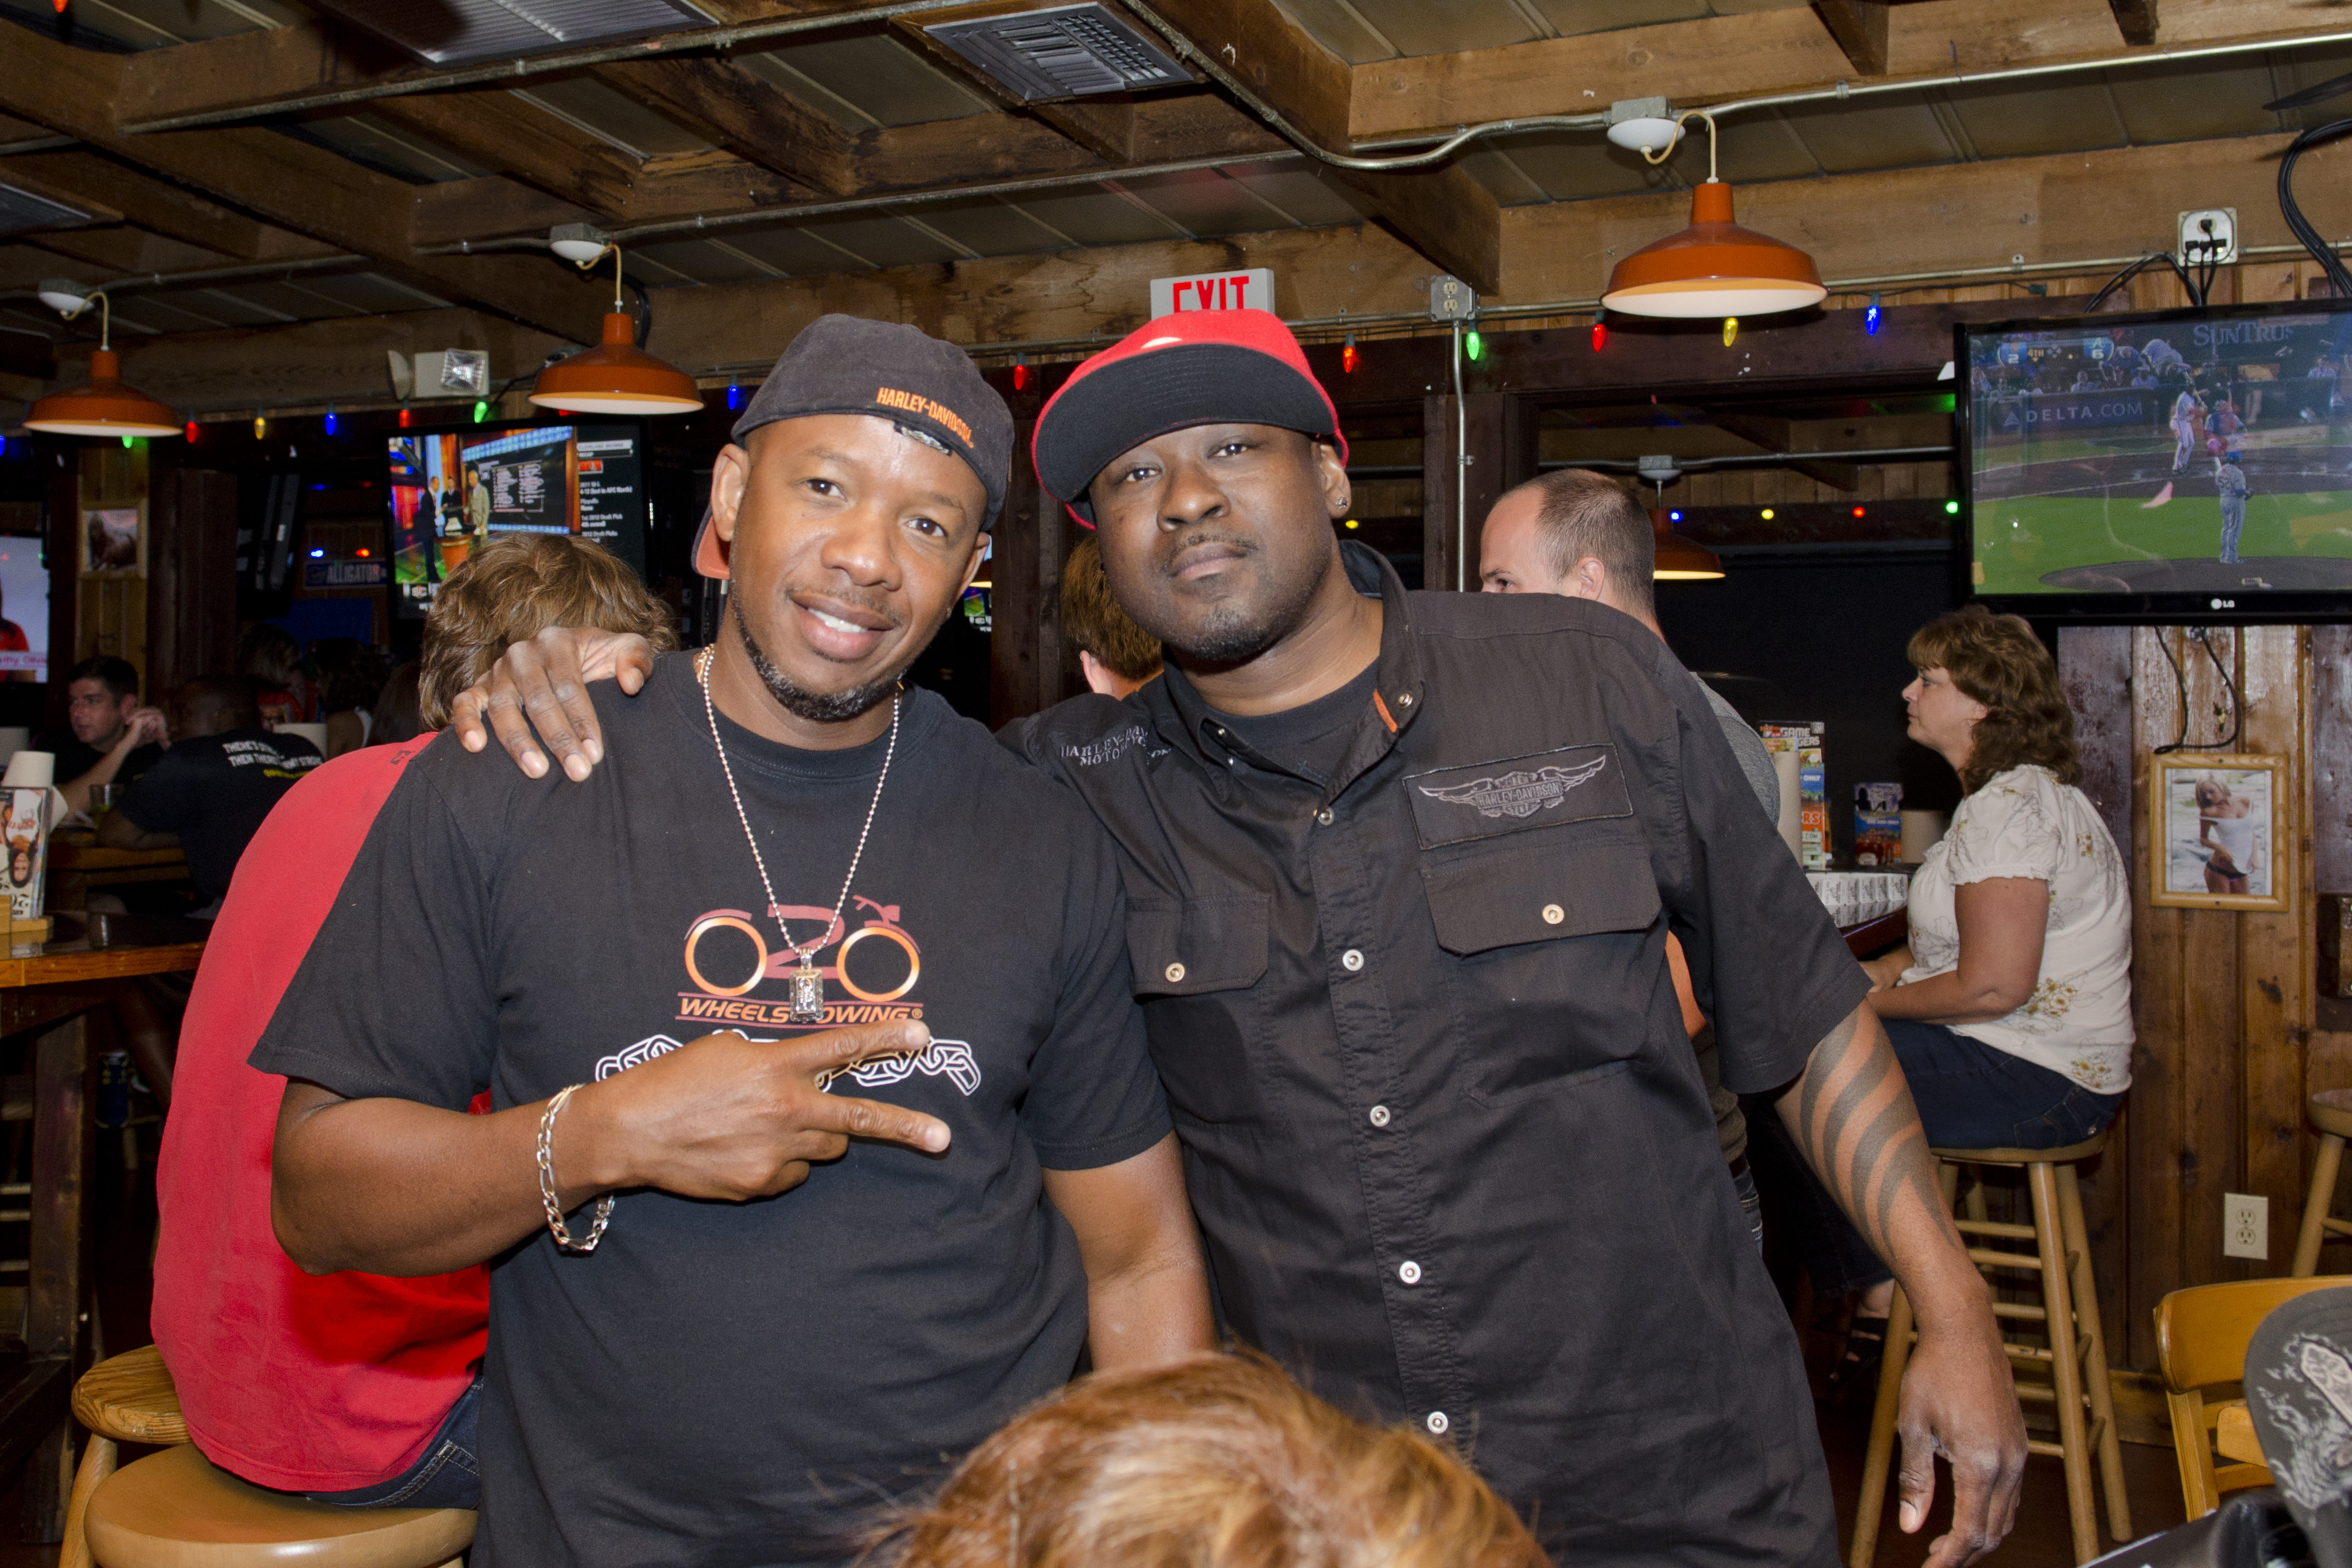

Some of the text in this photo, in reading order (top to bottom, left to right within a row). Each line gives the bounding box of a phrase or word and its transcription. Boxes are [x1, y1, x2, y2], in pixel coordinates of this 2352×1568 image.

[2007, 354, 2020, 364] 2
[2091, 349, 2105, 359] 6
[876, 387, 973, 447] HARLEY-DAVIDSON
[2026, 401, 2143, 422] DELTA.COM
[2219, 477, 2230, 489] 52
[1780, 727, 1810, 738] GAME
[1477, 781, 1560, 807] HARLEY-DAVIDSON
[680, 998, 910, 1024] WHEELS OWING
